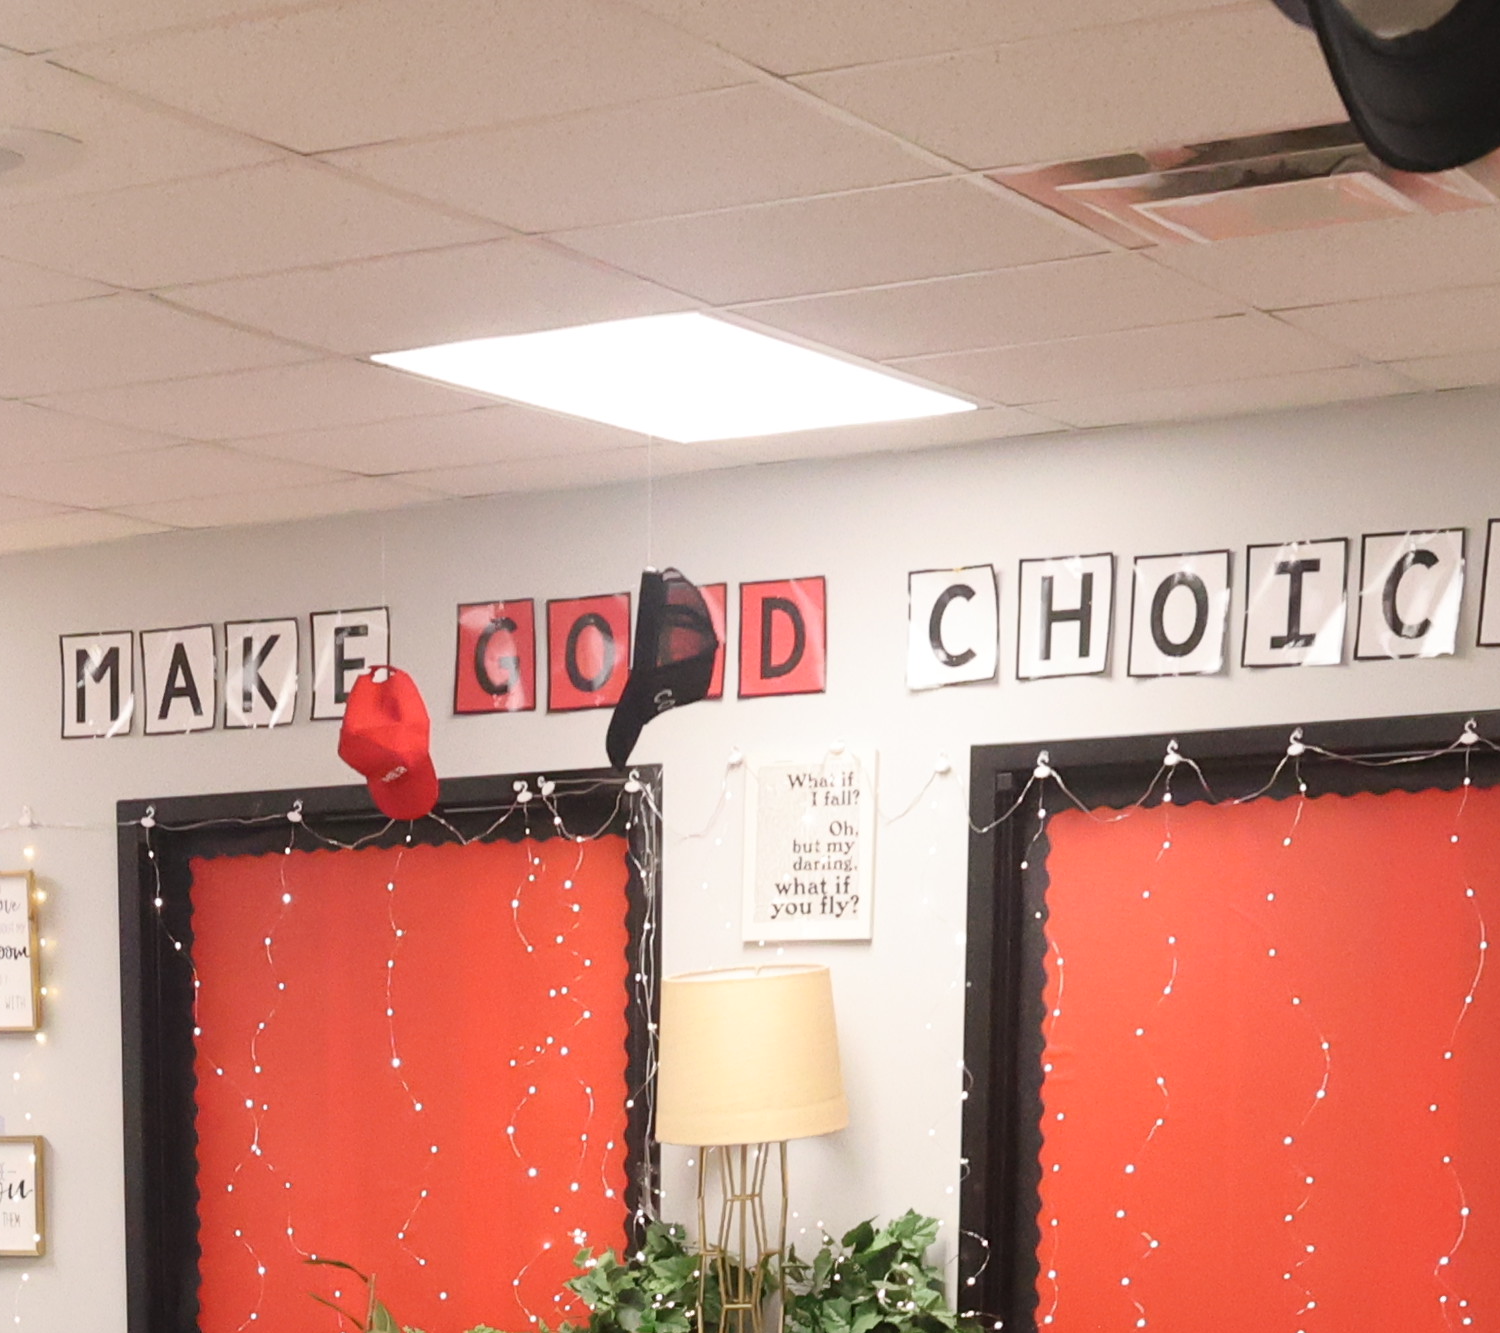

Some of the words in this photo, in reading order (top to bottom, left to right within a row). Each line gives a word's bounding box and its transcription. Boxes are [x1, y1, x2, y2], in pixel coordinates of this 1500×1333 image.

[74, 624, 369, 723] MAKE
[474, 596, 806, 697] GOD
[788, 773, 835, 789] What
[842, 771, 855, 787] if
[811, 792, 817, 806] I
[825, 790, 860, 806] fall?
[829, 821, 858, 837] Oh,
[793, 840, 820, 853] but
[827, 841, 856, 855] my
[775, 878, 828, 895] what
[835, 875, 851, 895] if
[771, 900, 812, 919] you
[821, 895, 860, 917] fly?
